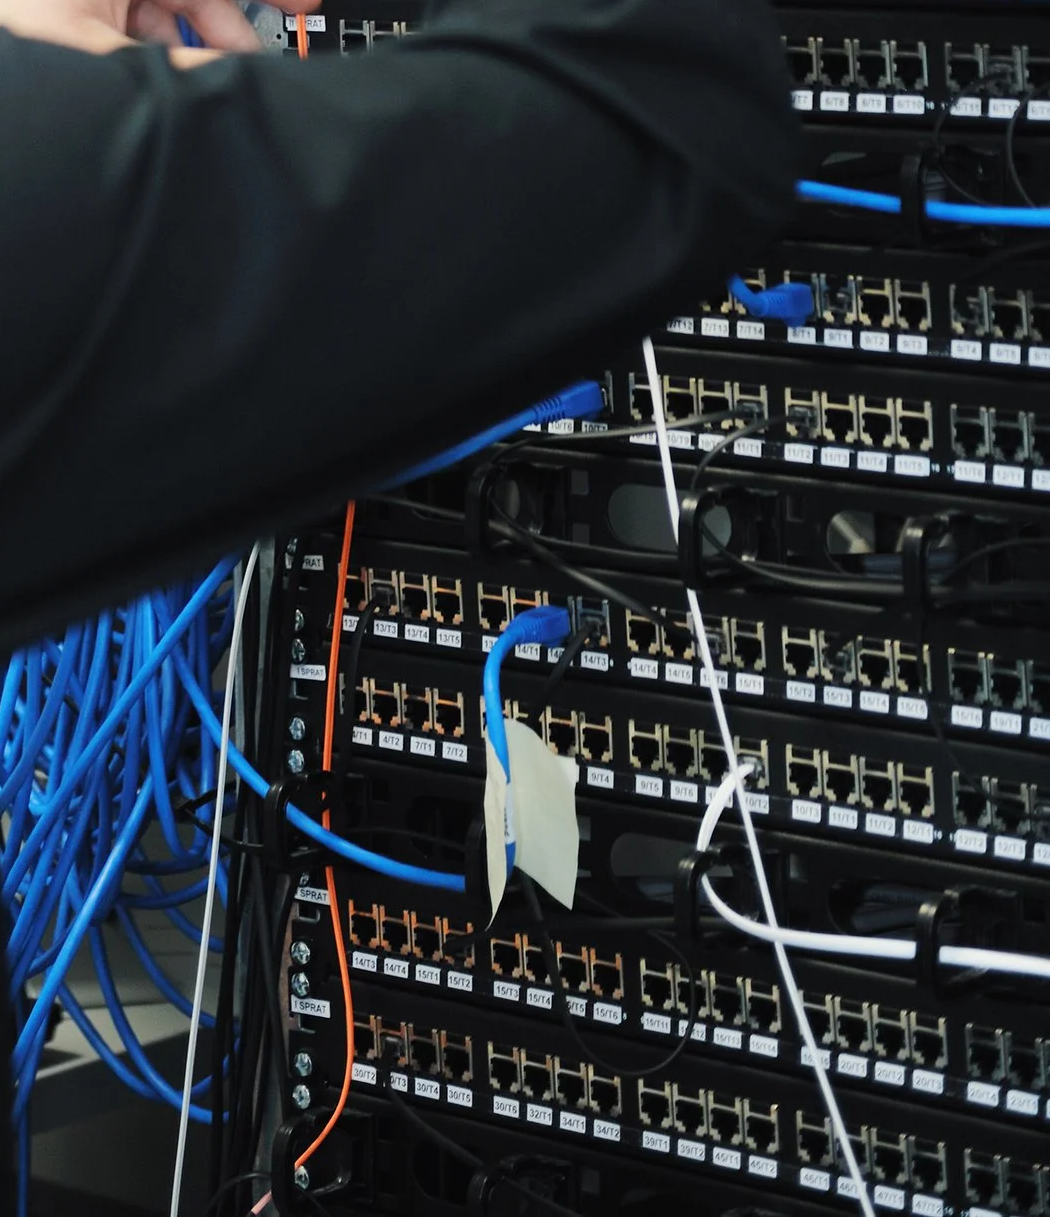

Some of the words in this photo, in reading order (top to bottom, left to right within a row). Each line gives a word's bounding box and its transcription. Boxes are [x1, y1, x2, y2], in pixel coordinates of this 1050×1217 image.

[704, 323, 728, 333] 7/T13
[740, 325, 764, 336] 7/T14
[864, 336, 884, 347] 9/T2
[551, 421, 572, 431] 10/T6
[737, 443, 760, 453] 11/T1
[788, 447, 811, 459] 11/T2
[824, 453, 848, 465] 11/T3
[860, 456, 884, 467] 11/T4
[376, 623, 396, 633] 13/T3
[407, 628, 428, 639] 13/T4
[438, 633, 460, 644] 13/T5
[517, 645, 539, 656] 14/T1
[584, 655, 606, 666] 14/T3
[300, 667, 324, 677] SPRAT
[634, 663, 657, 674] 14/T4
[668, 669, 691, 680] 14/T5
[739, 678, 762, 689] 15/T1
[789, 687, 814, 698] 15/T2
[826, 691, 851, 702] 15/T3
[862, 695, 887, 707] 15/T4
[383, 736, 400, 747] 4/T2
[415, 741, 432, 753] 7/T1
[446, 747, 464, 757] 7/T2
[591, 773, 610, 784] 9/T4
[640, 781, 659, 791] 9/T5
[674, 787, 694, 797] 9/T6
[796, 805, 819, 818] 10/T3
[832, 812, 855, 825] 11/T1
[868, 819, 892, 831] 11/T2
[300, 889, 327, 901] SPRAT
[355, 957, 376, 970] 14/T3
[385, 963, 406, 975] 14/T4
[418, 969, 439, 981] 15/T1
[449, 975, 470, 989] 15/T2
[496, 985, 518, 998] 15/T3
[528, 992, 551, 1005] 15/T4
[298, 1001, 326, 1014] SPRAT
[594, 1007, 618, 1021] 15/T6
[646, 1019, 668, 1030] 15/T11
[716, 1033, 741, 1045] 15/T13
[751, 1041, 776, 1053] 15/T14
[840, 1060, 866, 1073] 20/T1
[354, 1069, 375, 1081] 30/T2
[876, 1067, 902, 1081] 20/T2
[914, 1075, 942, 1089] 20/T3
[416, 1083, 438, 1095] 30/T4
[448, 1091, 471, 1103] 30/T5
[495, 1102, 518, 1114] 30/T6
[529, 1110, 551, 1122] 32/T1
[562, 1117, 585, 1129] 34/T1
[596, 1125, 620, 1139] 34/T2
[645, 1136, 668, 1149] 39/T1
[680, 1145, 704, 1157] 39/T2
[715, 1151, 740, 1165] 45/T1
[750, 1159, 776, 1173] 45/T2
[877, 1190, 904, 1205] 47/T1
[915, 1199, 942, 1213] 47/T2
